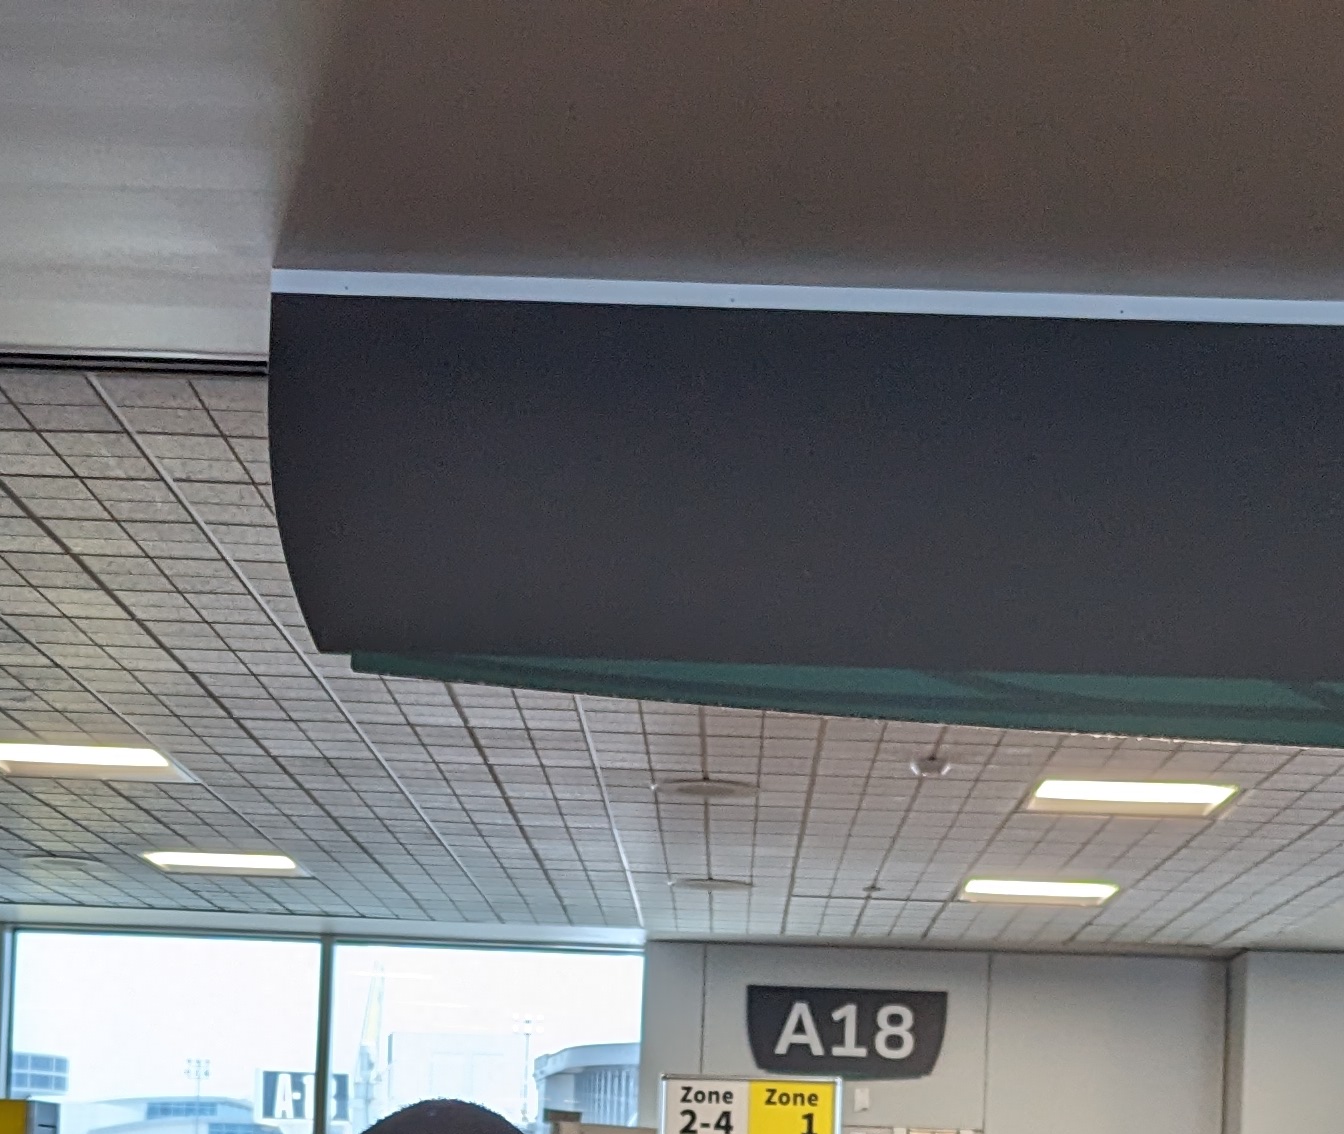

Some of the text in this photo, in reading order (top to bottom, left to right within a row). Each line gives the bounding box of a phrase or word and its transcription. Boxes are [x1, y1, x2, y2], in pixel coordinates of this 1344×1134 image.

[773, 1001, 916, 1060] A18
[679, 1085, 734, 1105] Zone
[764, 1087, 819, 1107] Zone
